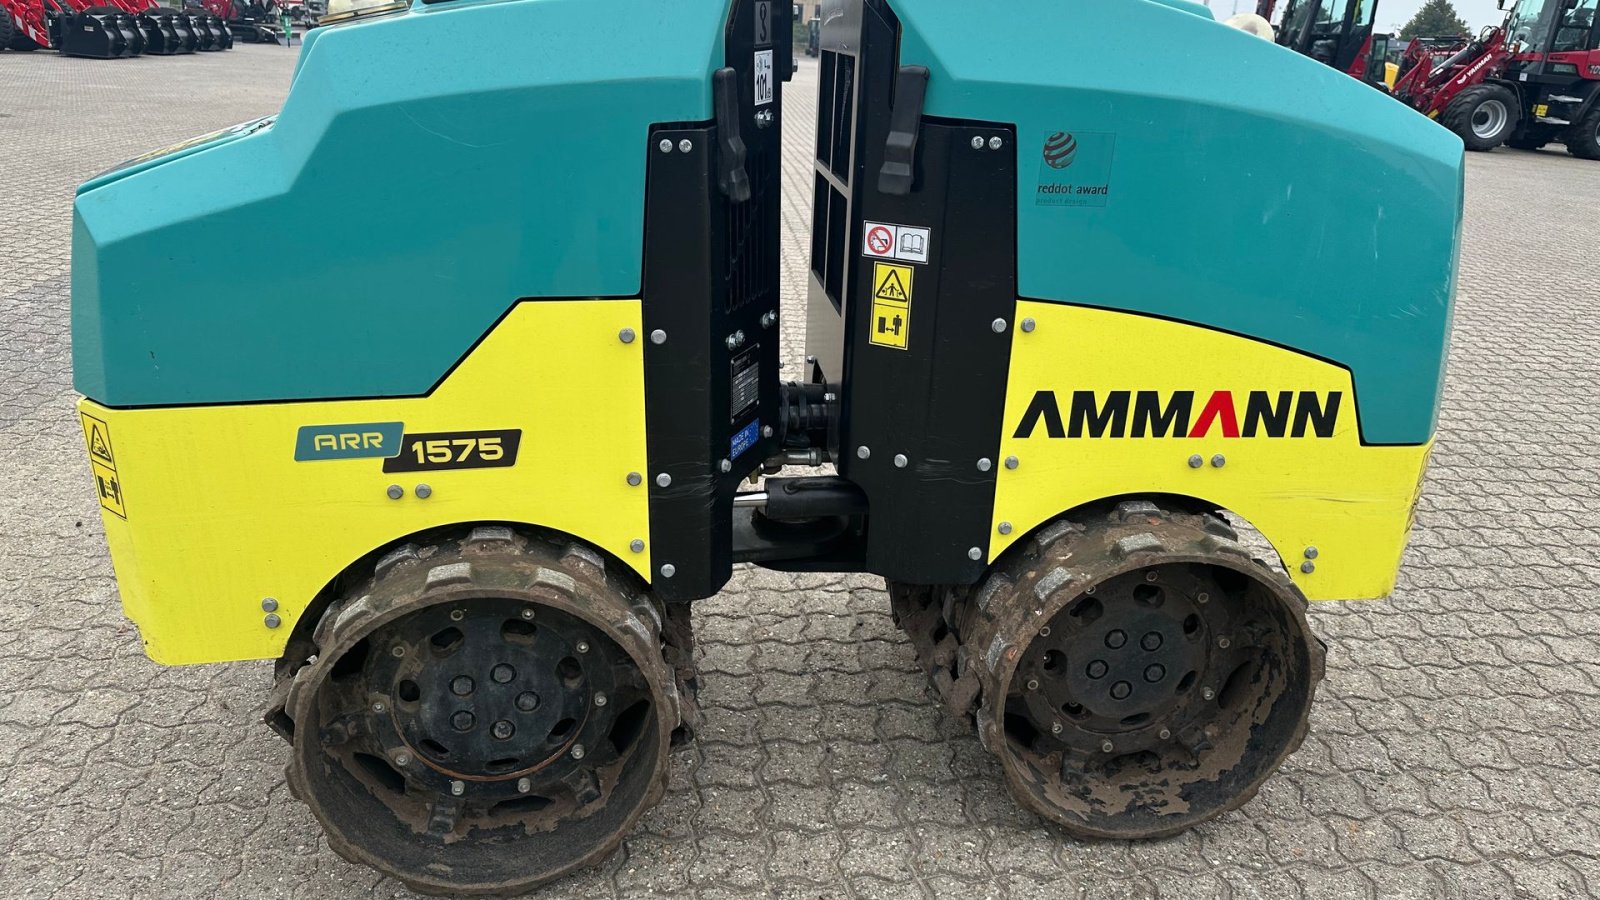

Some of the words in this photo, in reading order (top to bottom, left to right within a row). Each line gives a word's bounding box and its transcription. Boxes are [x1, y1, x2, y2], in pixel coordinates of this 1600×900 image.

[1466, 53, 1492, 77] YANMAR
[756, 73, 767, 101] 101
[1076, 184, 1109, 195] award
[1012, 390, 1342, 438] AMMANN
[314, 431, 383, 451] ARR
[411, 437, 504, 464] 1575
